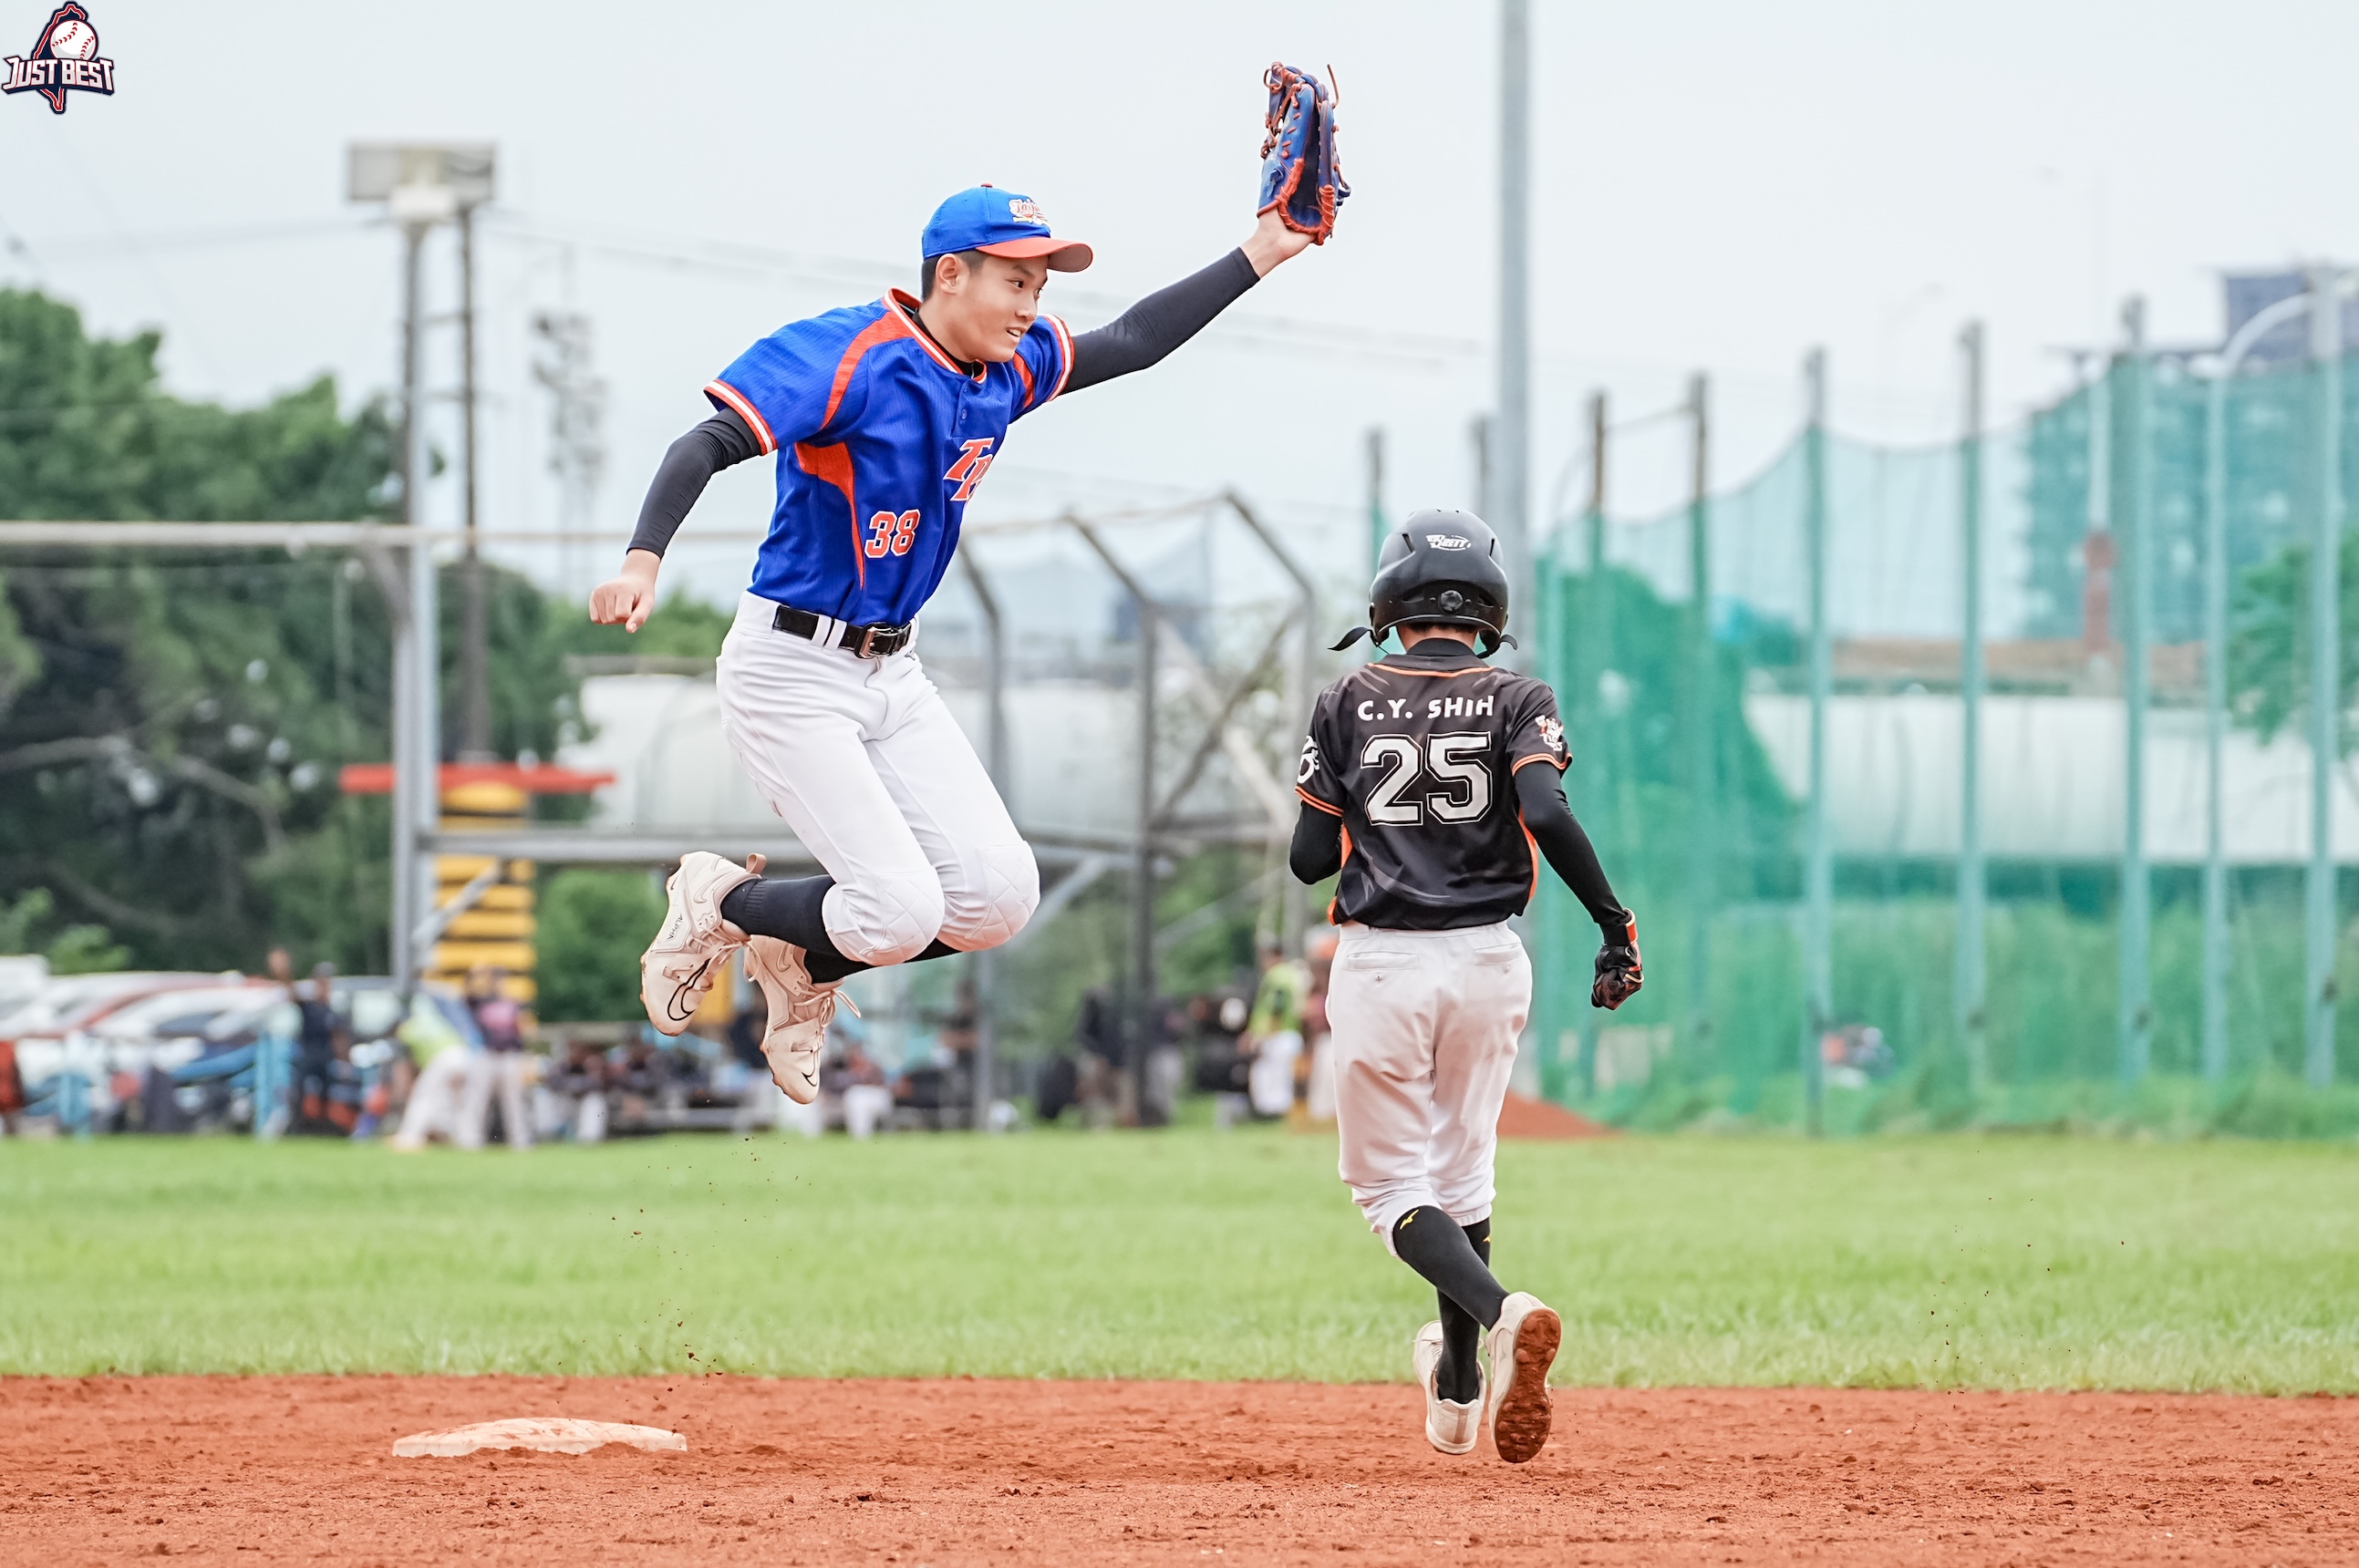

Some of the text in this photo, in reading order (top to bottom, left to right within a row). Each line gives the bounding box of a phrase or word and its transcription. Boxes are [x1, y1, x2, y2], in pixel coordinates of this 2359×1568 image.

[864, 509, 921, 559] 38
[1357, 695, 1495, 721] C.Y. SHIH
[1361, 731, 1492, 826] 25
[667, 913, 683, 940] ALPHA
